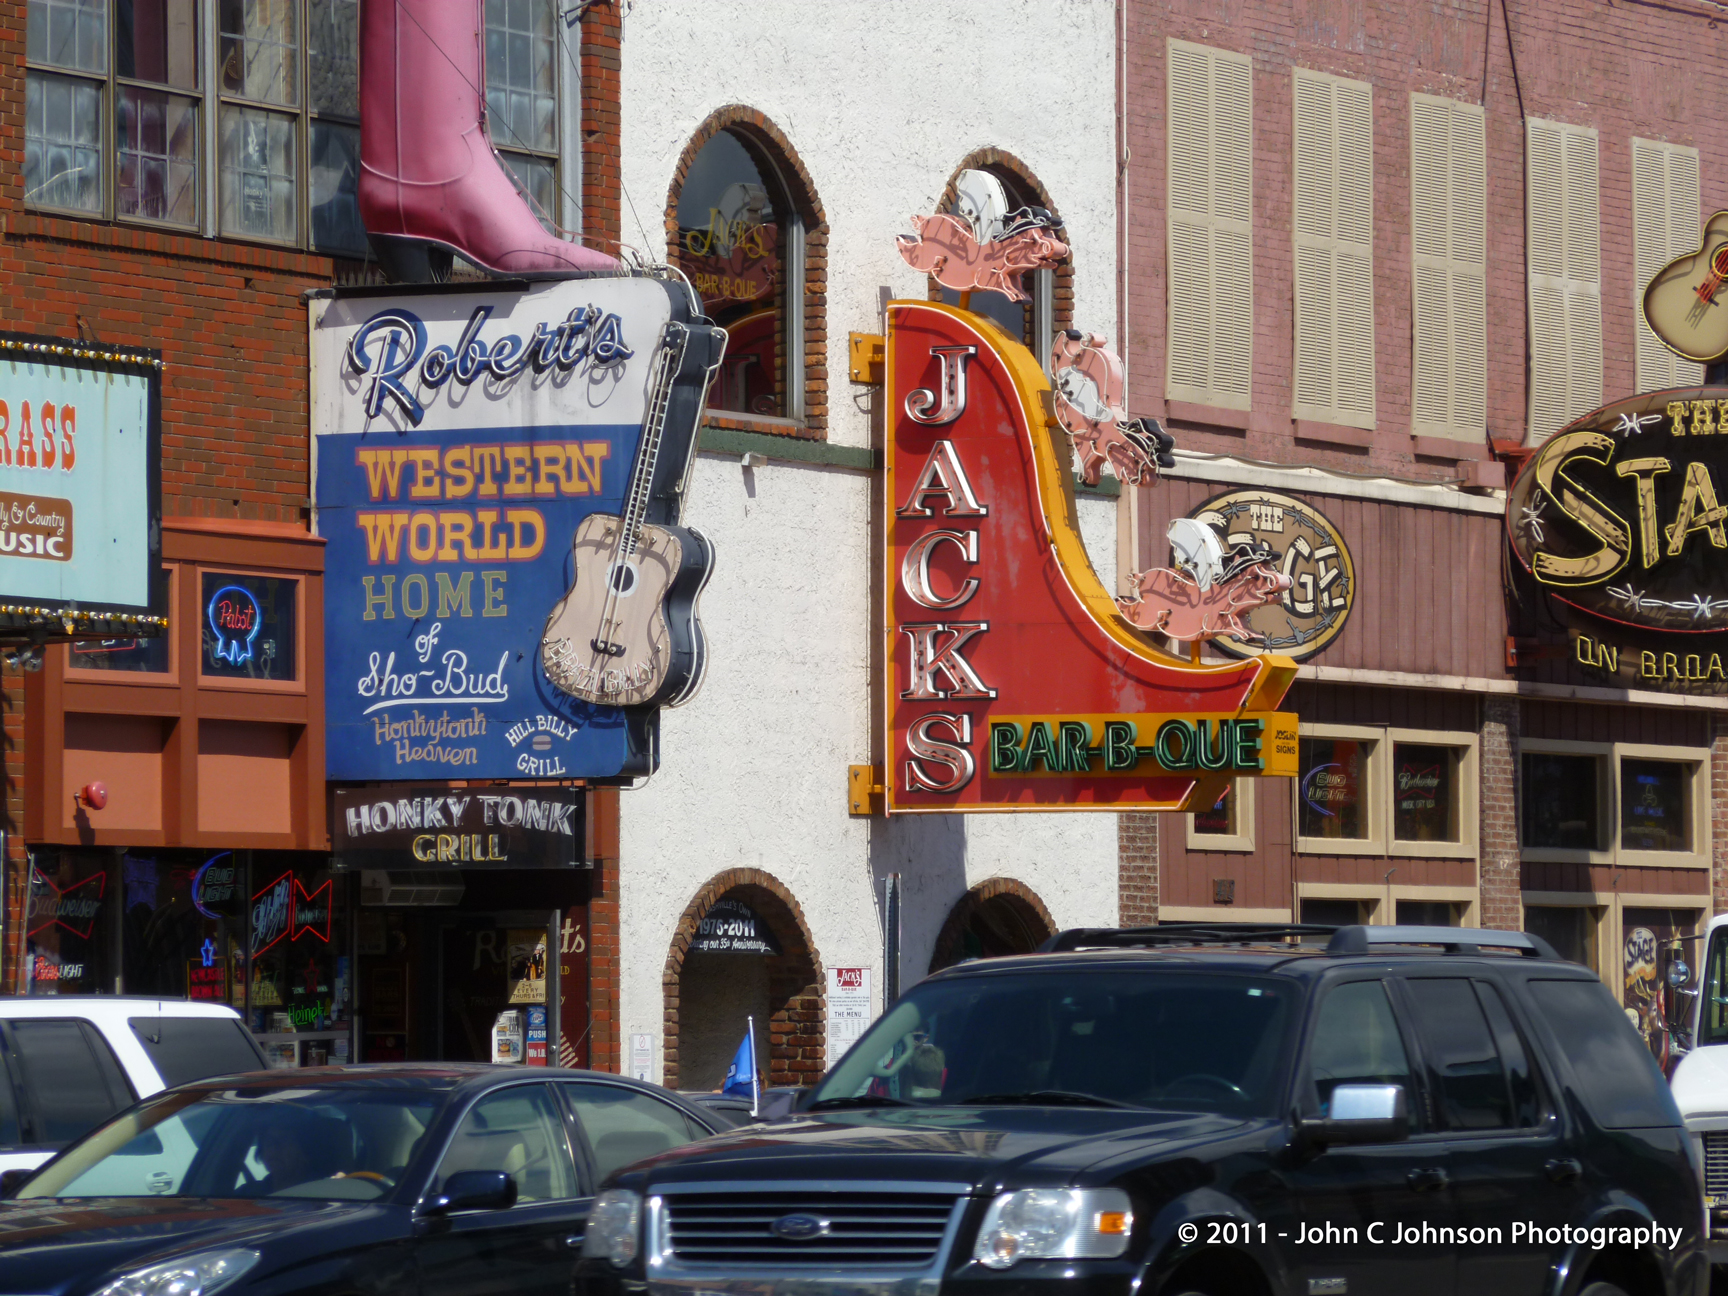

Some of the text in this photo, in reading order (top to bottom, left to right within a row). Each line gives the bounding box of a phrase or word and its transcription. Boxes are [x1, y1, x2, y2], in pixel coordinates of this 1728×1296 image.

[346, 304, 634, 428] Robert's
[355, 440, 610, 501] WESTERN
[26, 502, 65, 535] Country
[1250, 504, 1284, 533] THE
[355, 507, 547, 564] WORLD
[895, 344, 998, 794] JACKS
[362, 571, 507, 621] HOME
[415, 622, 441, 662] of
[1577, 635, 1617, 672] ON
[371, 707, 487, 746] Honkytonk
[505, 715, 578, 747] HILL BILLY
[395, 740, 478, 764] Heaven
[990, 716, 1265, 775] BAR-B-QUE
[1275, 745, 1296, 755] SIGNS
[516, 753, 566, 776] GRILL
[1316, 772, 1346, 786] BUD
[1308, 788, 1347, 800] LIGHT
[346, 796, 578, 837] HONKY TONK
[413, 834, 507, 862] GRILL
[204, 867, 234, 883] BUD
[197, 886, 233, 903] LIGHT
[699, 918, 755, 937] 1976-2011
[1626, 937, 1654, 965] STAGE
[58, 964, 83, 979] LIGHT
[837, 970, 862, 986] JACK'S
[529, 1031, 547, 1039] PUSH
